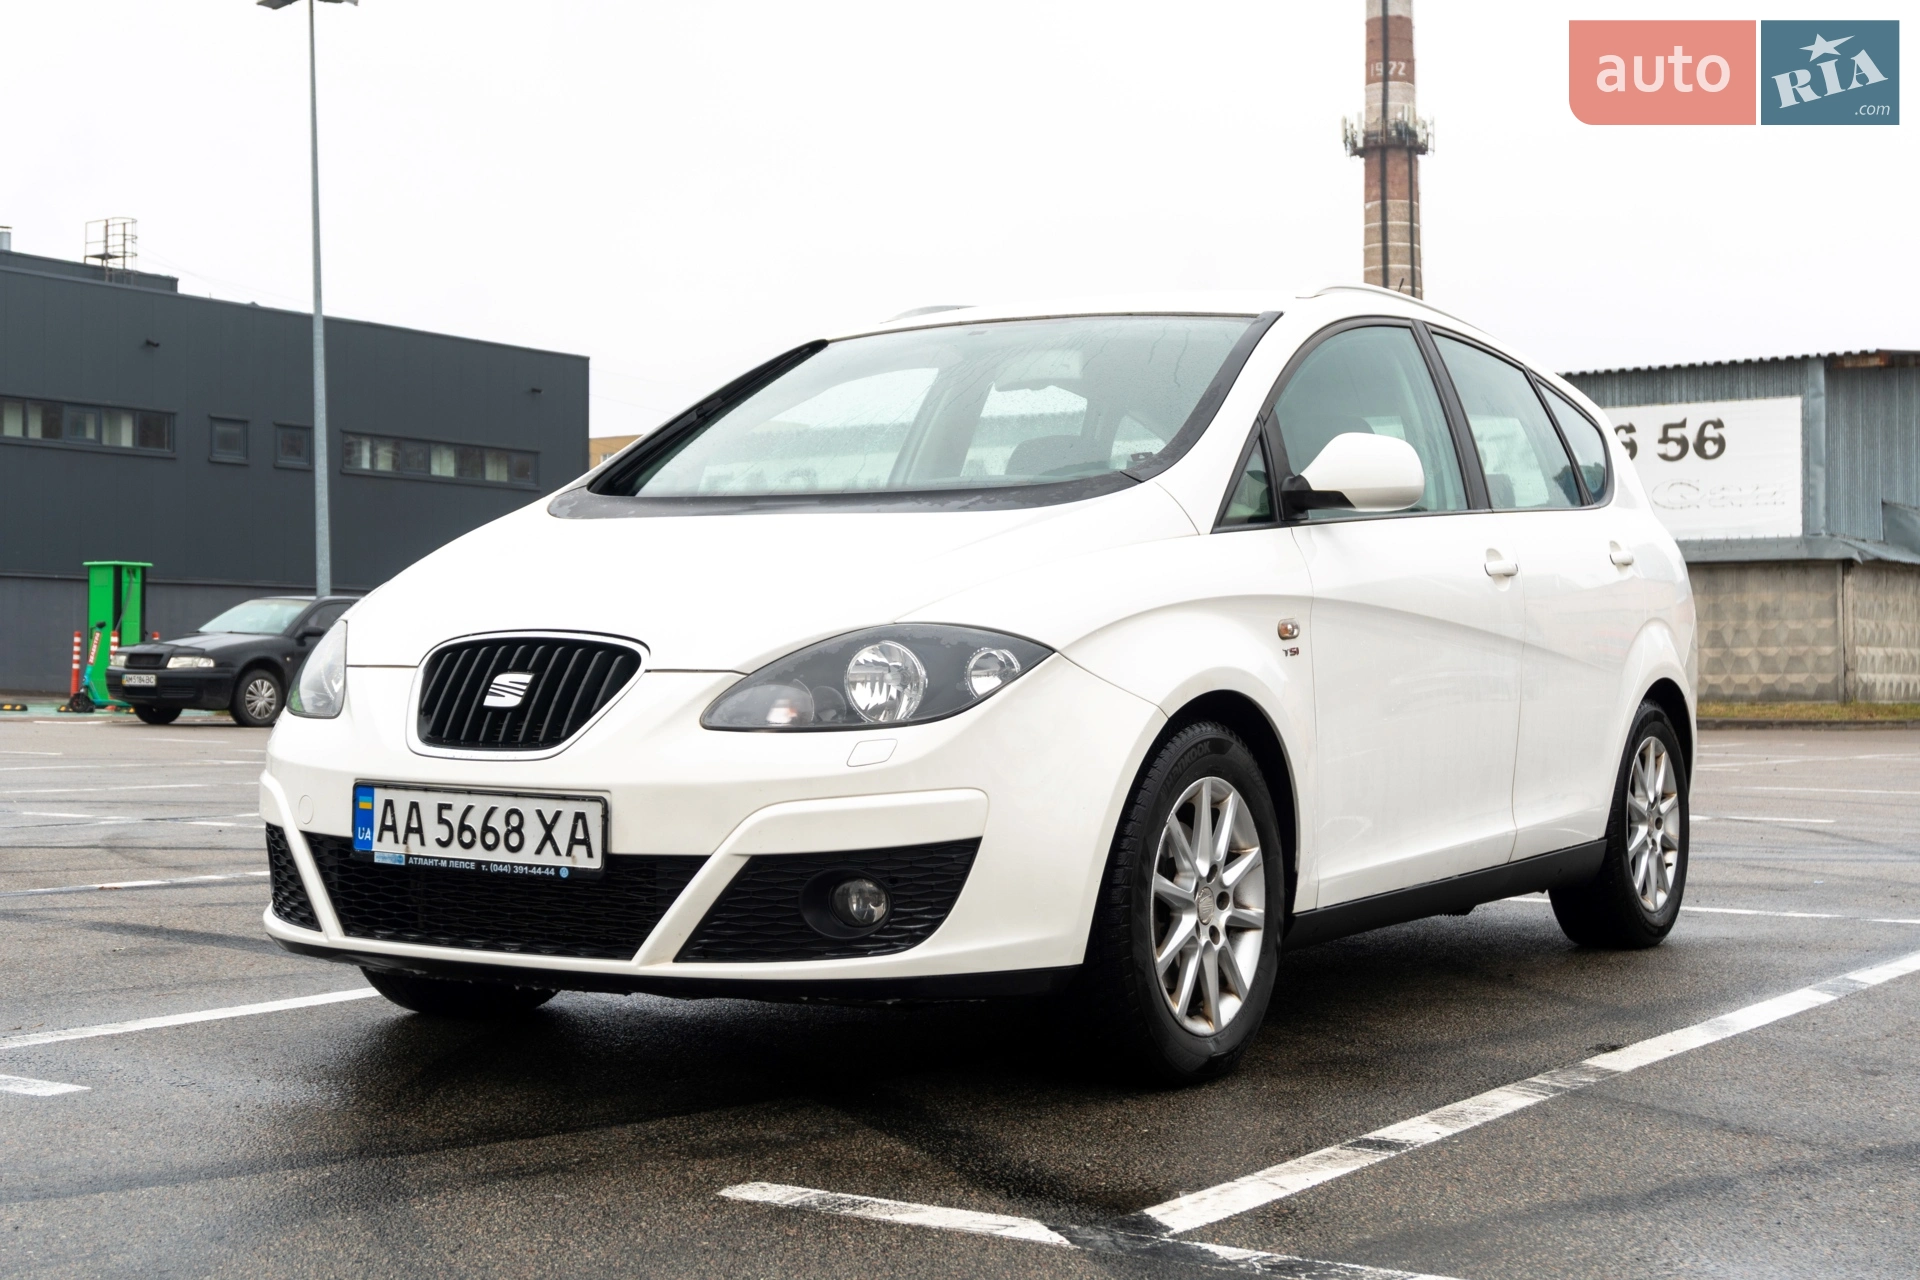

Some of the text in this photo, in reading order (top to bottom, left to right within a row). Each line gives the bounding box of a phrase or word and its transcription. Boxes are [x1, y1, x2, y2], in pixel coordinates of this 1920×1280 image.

[1371, 61, 1406, 77] 1972
[1657, 417, 1726, 462] 56
[1282, 647, 1299, 657] TSI
[358, 827, 372, 841] UA
[377, 799, 594, 858] AA 5668 XA
[408, 857, 447, 867] АТЛАНТ-М
[449, 860, 476, 870] ЛЕПСЕ
[490, 863, 511, 874] (044)
[513, 865, 555, 876] 391-44-44
